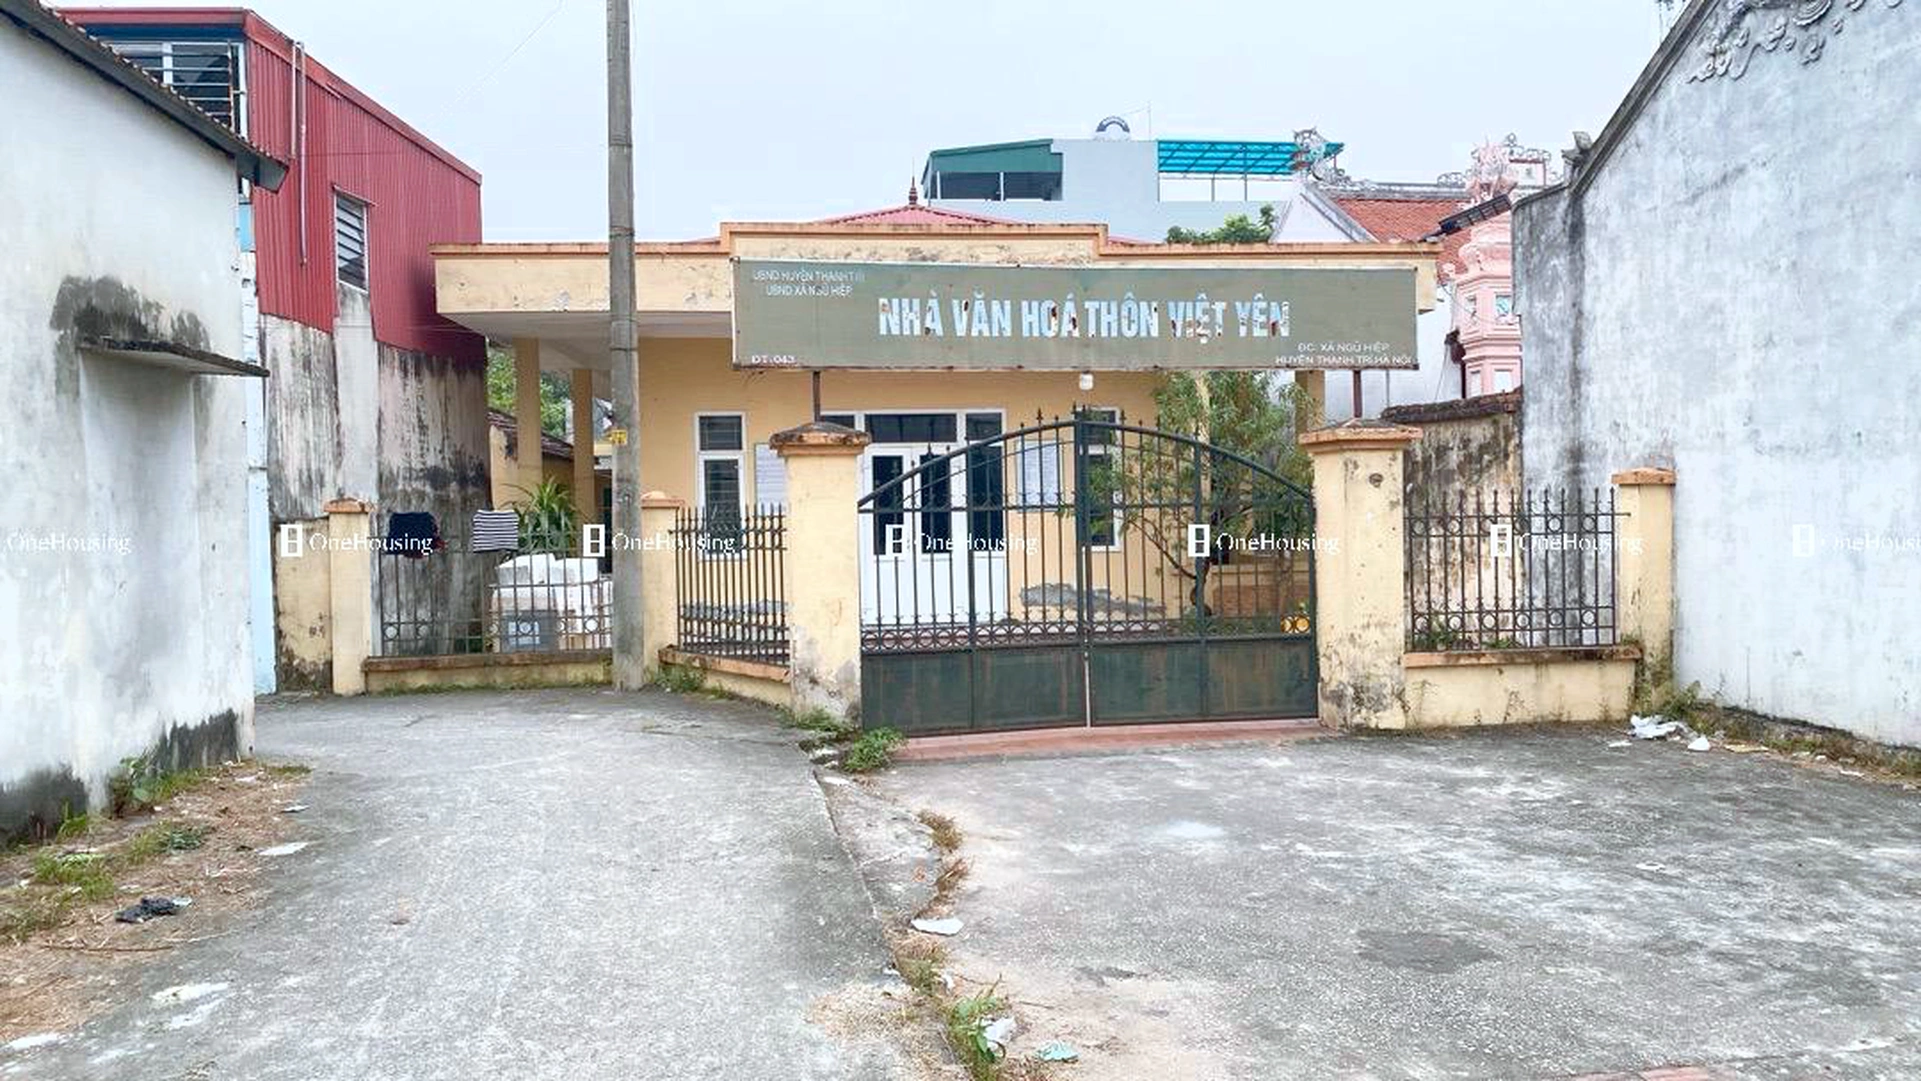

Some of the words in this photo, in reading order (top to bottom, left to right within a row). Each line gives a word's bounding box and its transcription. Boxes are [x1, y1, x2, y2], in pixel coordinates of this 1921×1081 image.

[879, 289, 944, 336] NHÀ
[952, 289, 1012, 337] VĂN
[1021, 292, 1079, 337] HOÁ
[1084, 292, 1159, 337] THÔN
[1167, 293, 1226, 344] VIỆT
[1235, 293, 1290, 337] YÊN
